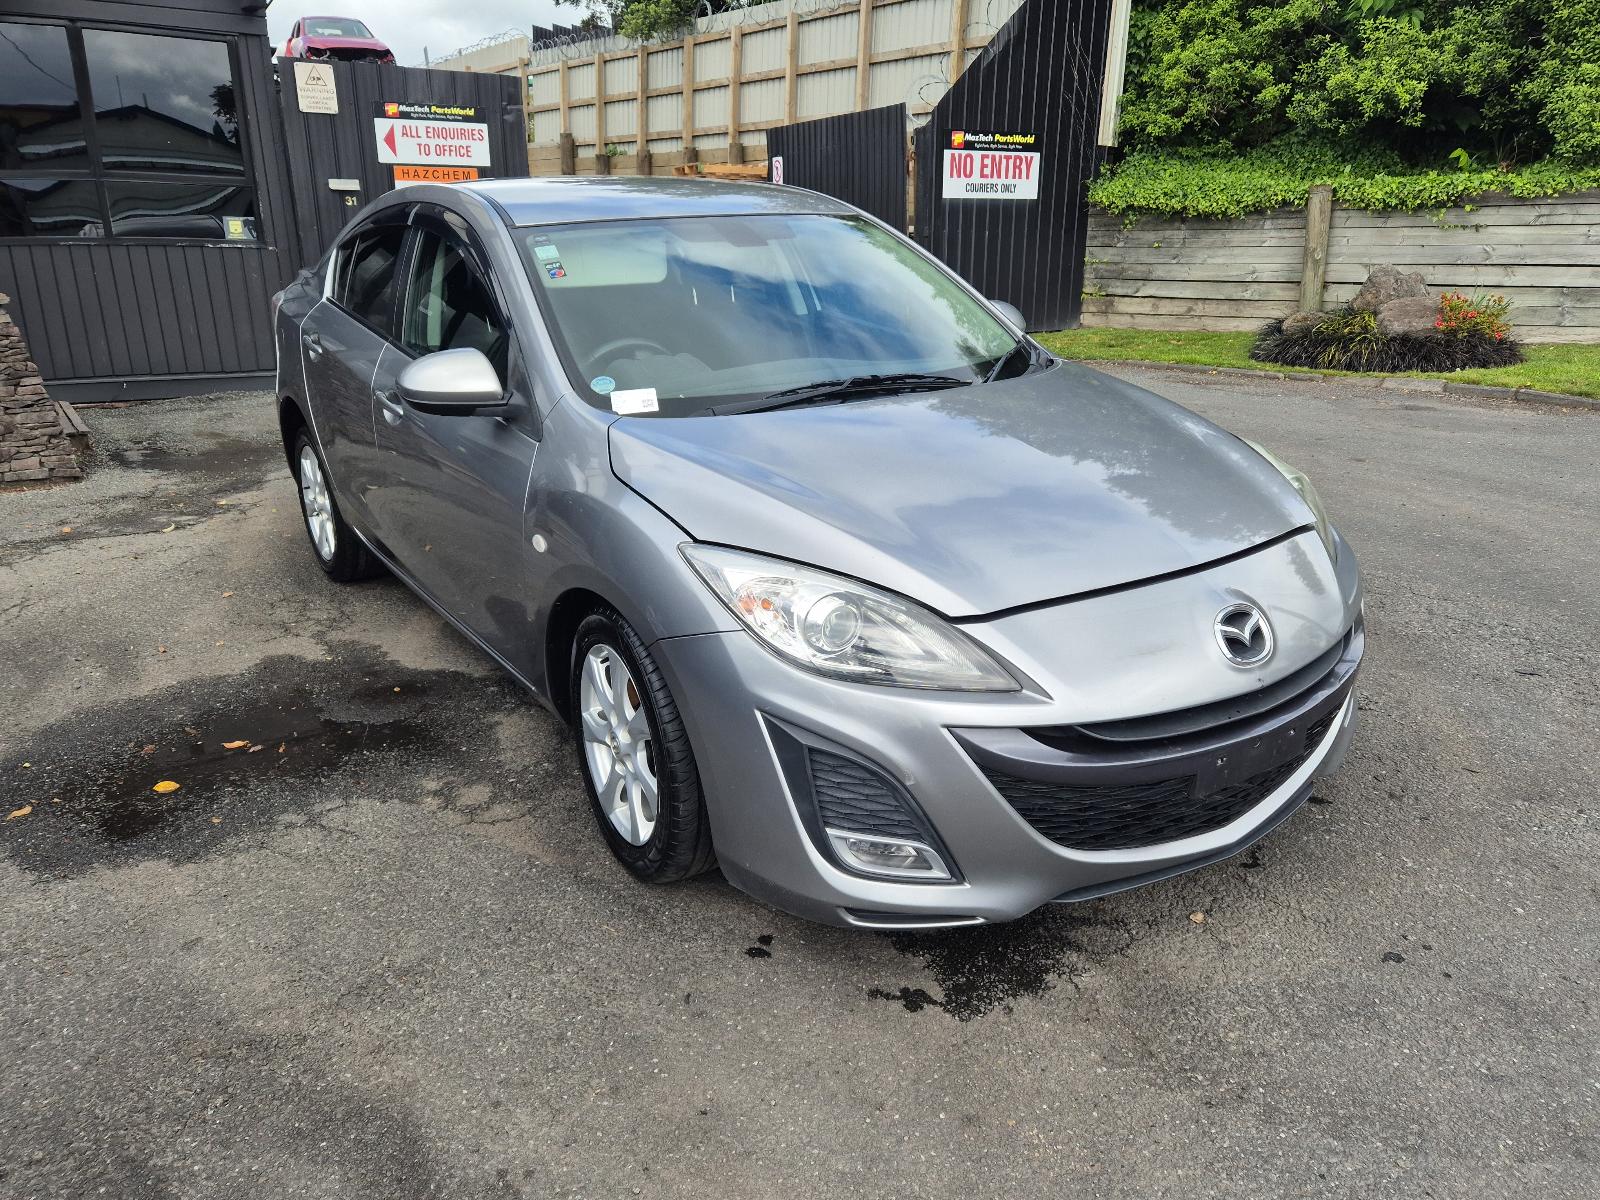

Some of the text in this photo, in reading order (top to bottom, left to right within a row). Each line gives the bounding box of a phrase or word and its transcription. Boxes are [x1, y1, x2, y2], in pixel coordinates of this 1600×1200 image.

[431, 106, 475, 116] PartsWorld
[401, 125, 484, 142] ALL ENQUIRIES
[994, 133, 1036, 144] PartsWorld
[417, 143, 472, 158] TO OFFICE
[949, 152, 1034, 180] NO ENTRY
[402, 169, 471, 180] HAZCHEM
[965, 182, 1017, 194] COURIERS ONLY
[345, 196, 357, 206] 31
